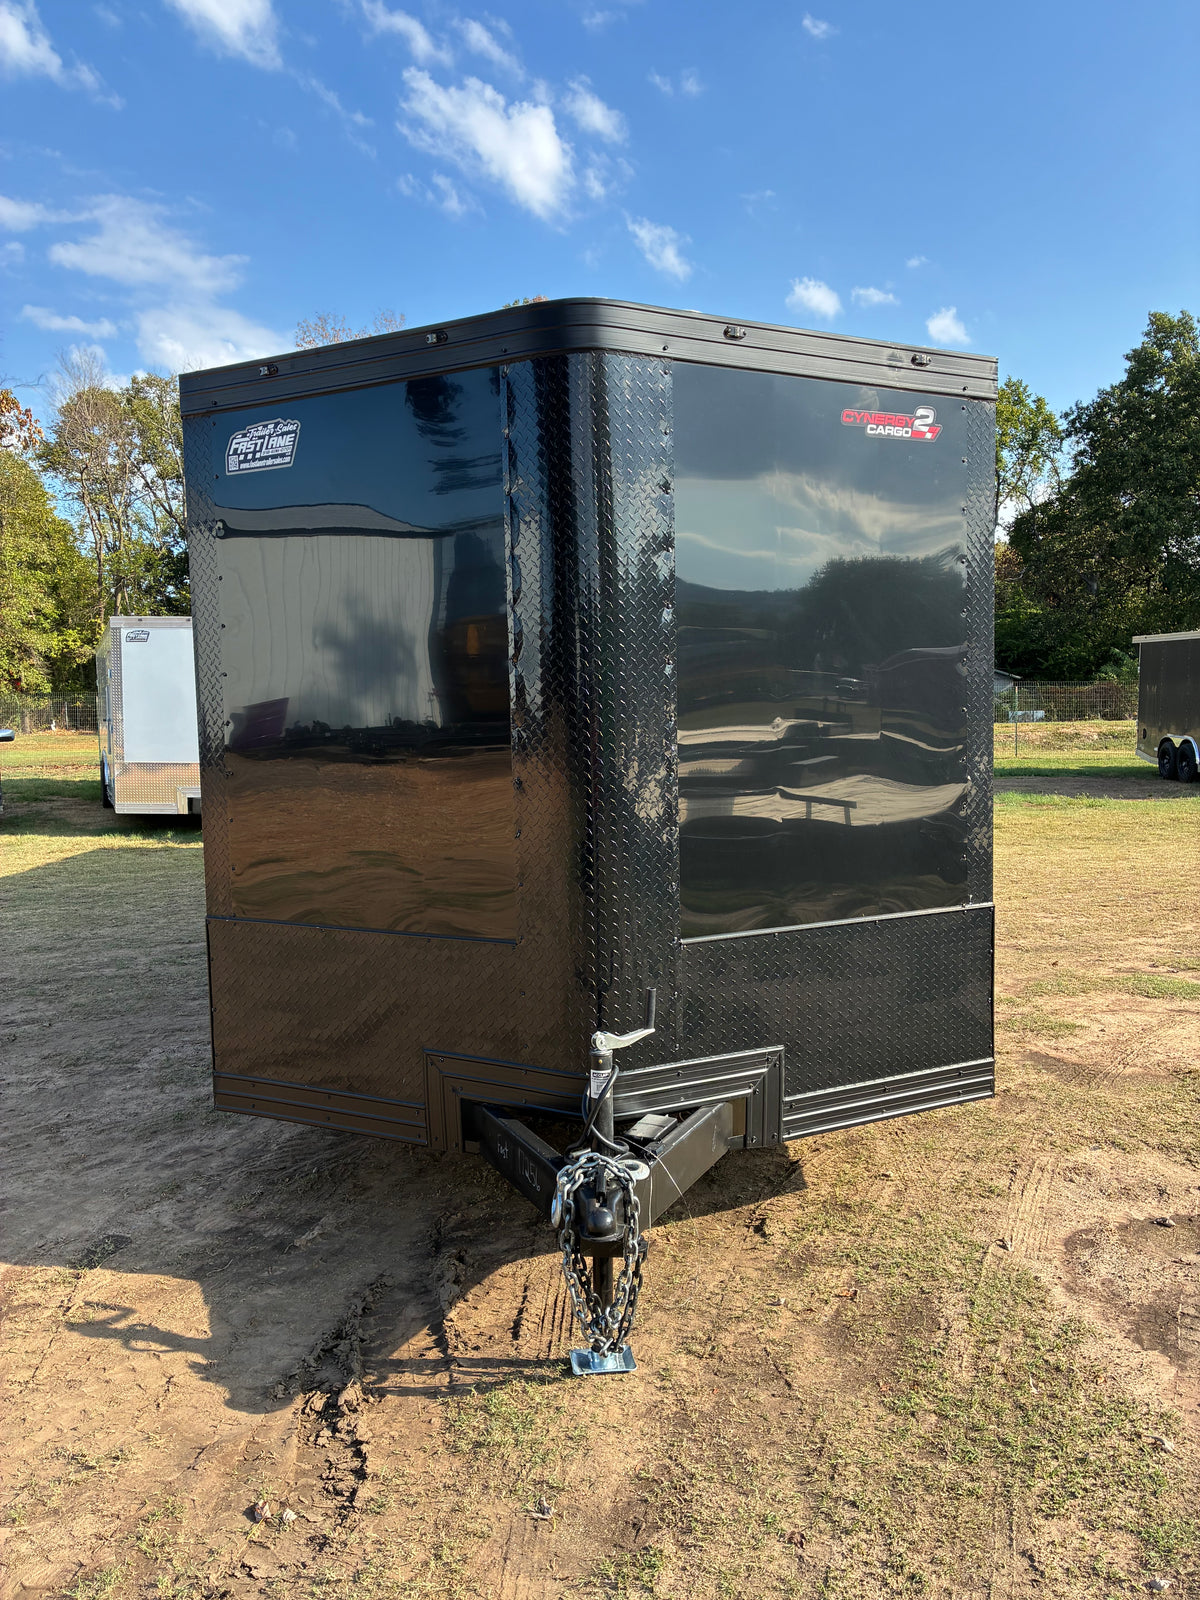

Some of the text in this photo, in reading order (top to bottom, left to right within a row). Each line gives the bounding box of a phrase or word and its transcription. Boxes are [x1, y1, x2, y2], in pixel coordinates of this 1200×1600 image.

[842, 408, 935, 432] CYNERGY 2
[246, 423, 298, 439] Trailer Sales
[867, 424, 912, 437] CARGO
